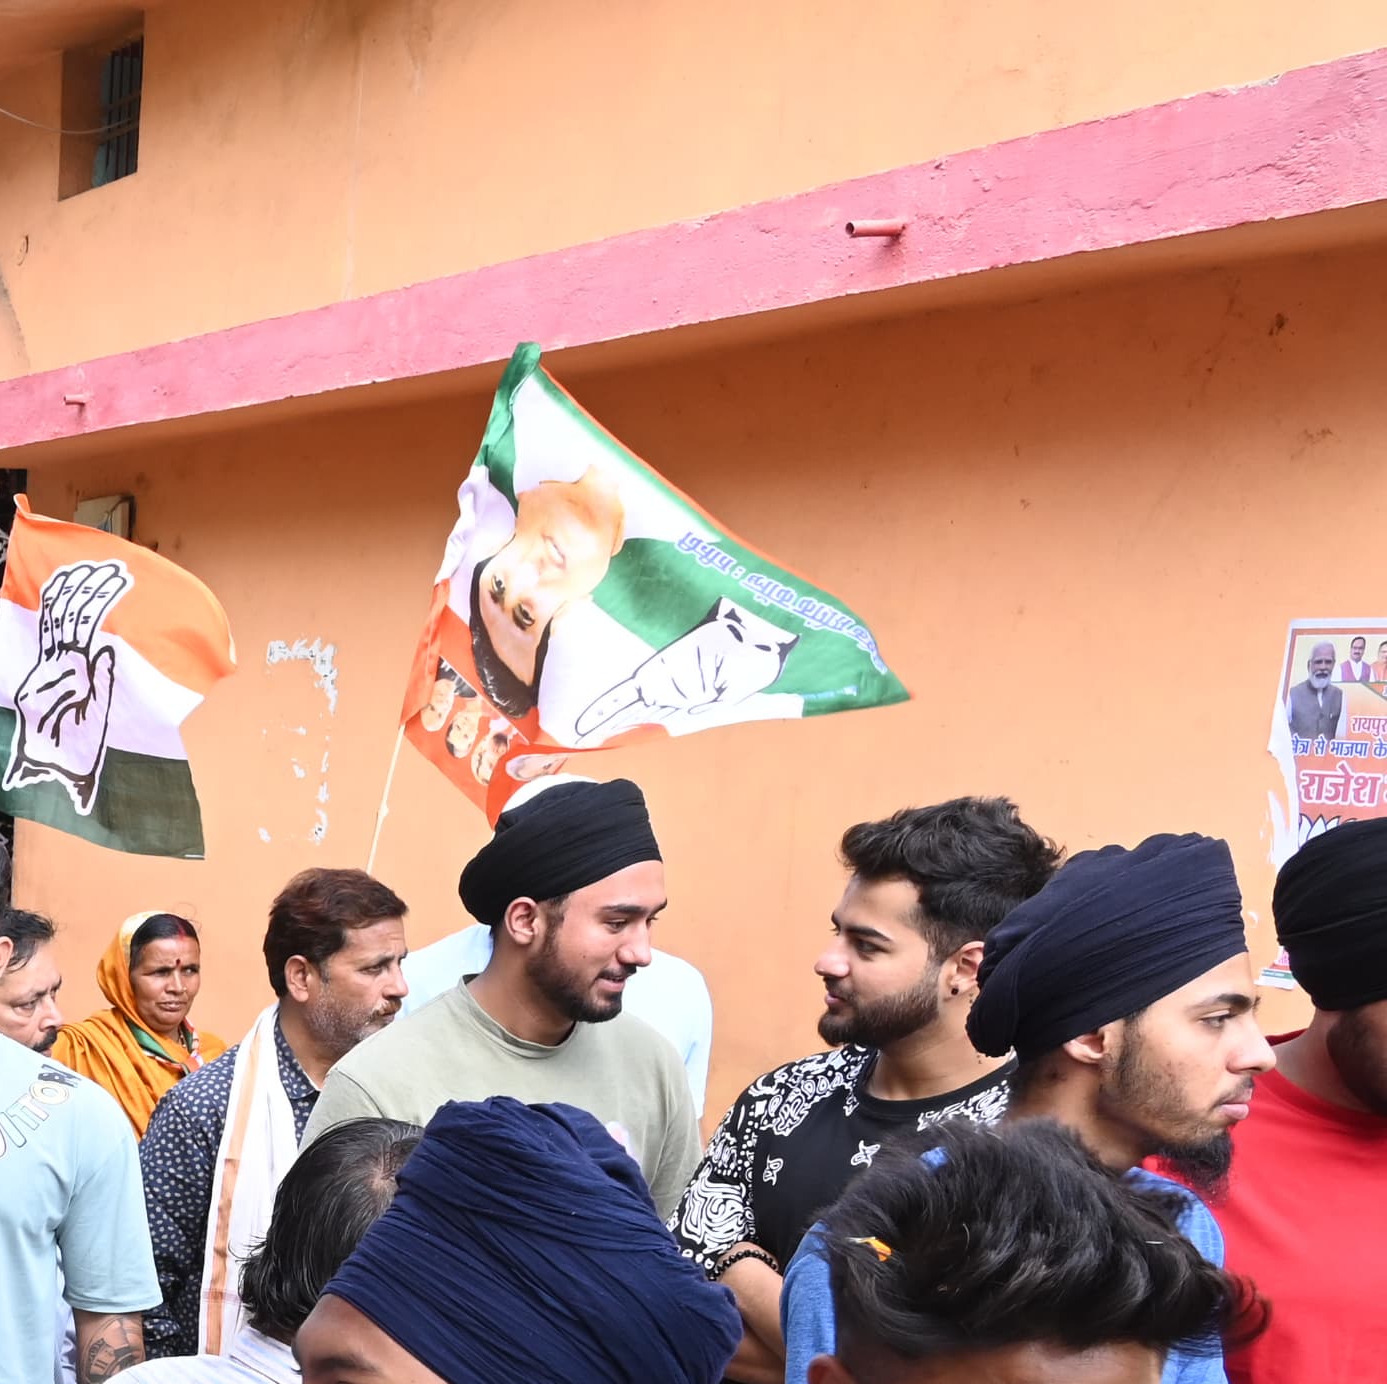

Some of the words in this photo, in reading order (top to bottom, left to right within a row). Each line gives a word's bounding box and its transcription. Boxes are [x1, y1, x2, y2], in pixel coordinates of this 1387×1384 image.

[1315, 736, 1325, 755] से
[1330, 741, 1368, 757] भाजपा
[1301, 763, 1381, 804] राजेश
